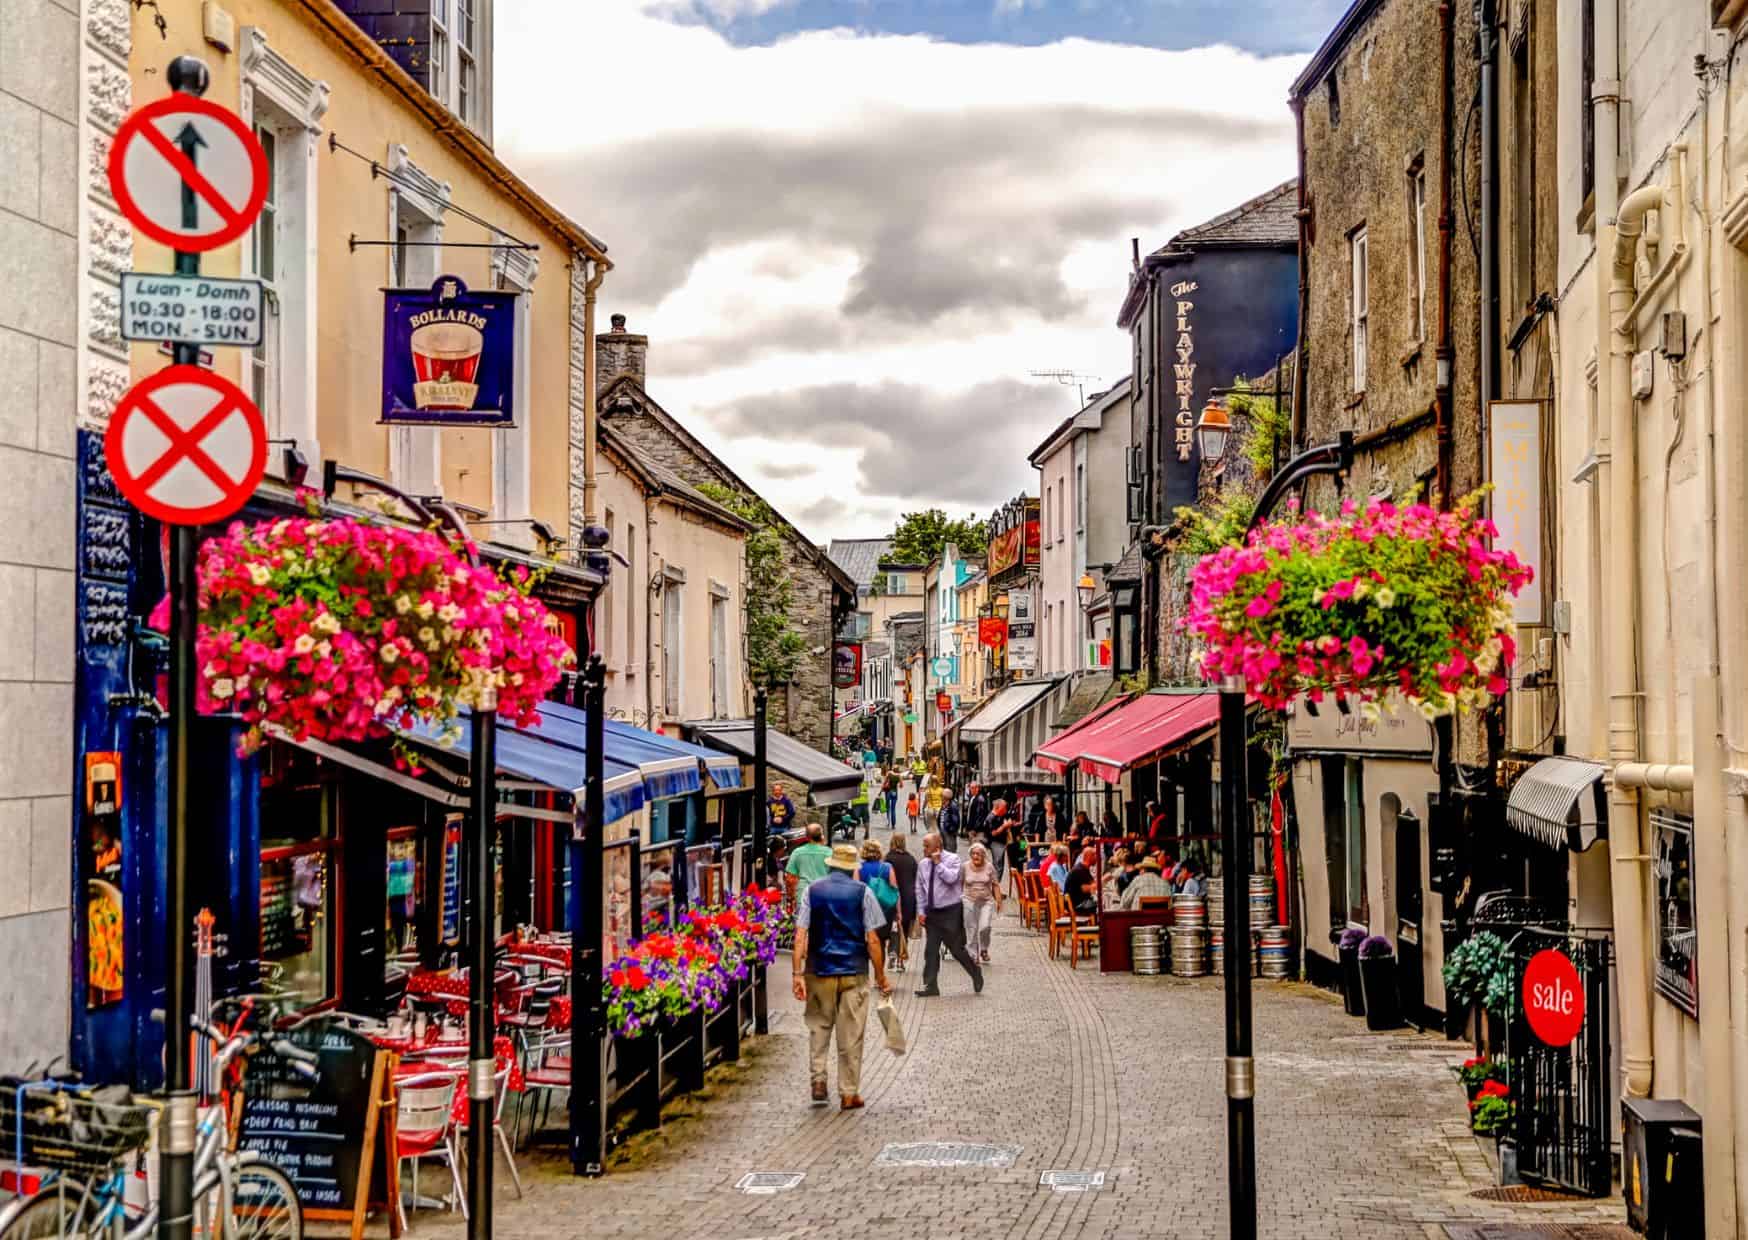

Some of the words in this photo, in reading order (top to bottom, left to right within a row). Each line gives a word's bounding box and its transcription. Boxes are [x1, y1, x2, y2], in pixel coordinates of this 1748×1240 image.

[135, 279, 181, 296] Luan
[196, 283, 250, 301] Domh
[1170, 280, 1198, 297] The
[129, 301, 185, 317] 10:30
[201, 305, 256, 322] 18:00
[409, 308, 487, 330] BOLLARDS
[132, 320, 188, 338] MON.
[204, 324, 255, 341] SUN.
[1172, 301, 1197, 463] PLAYWRIGHT
[1533, 976, 1574, 1016] sale
